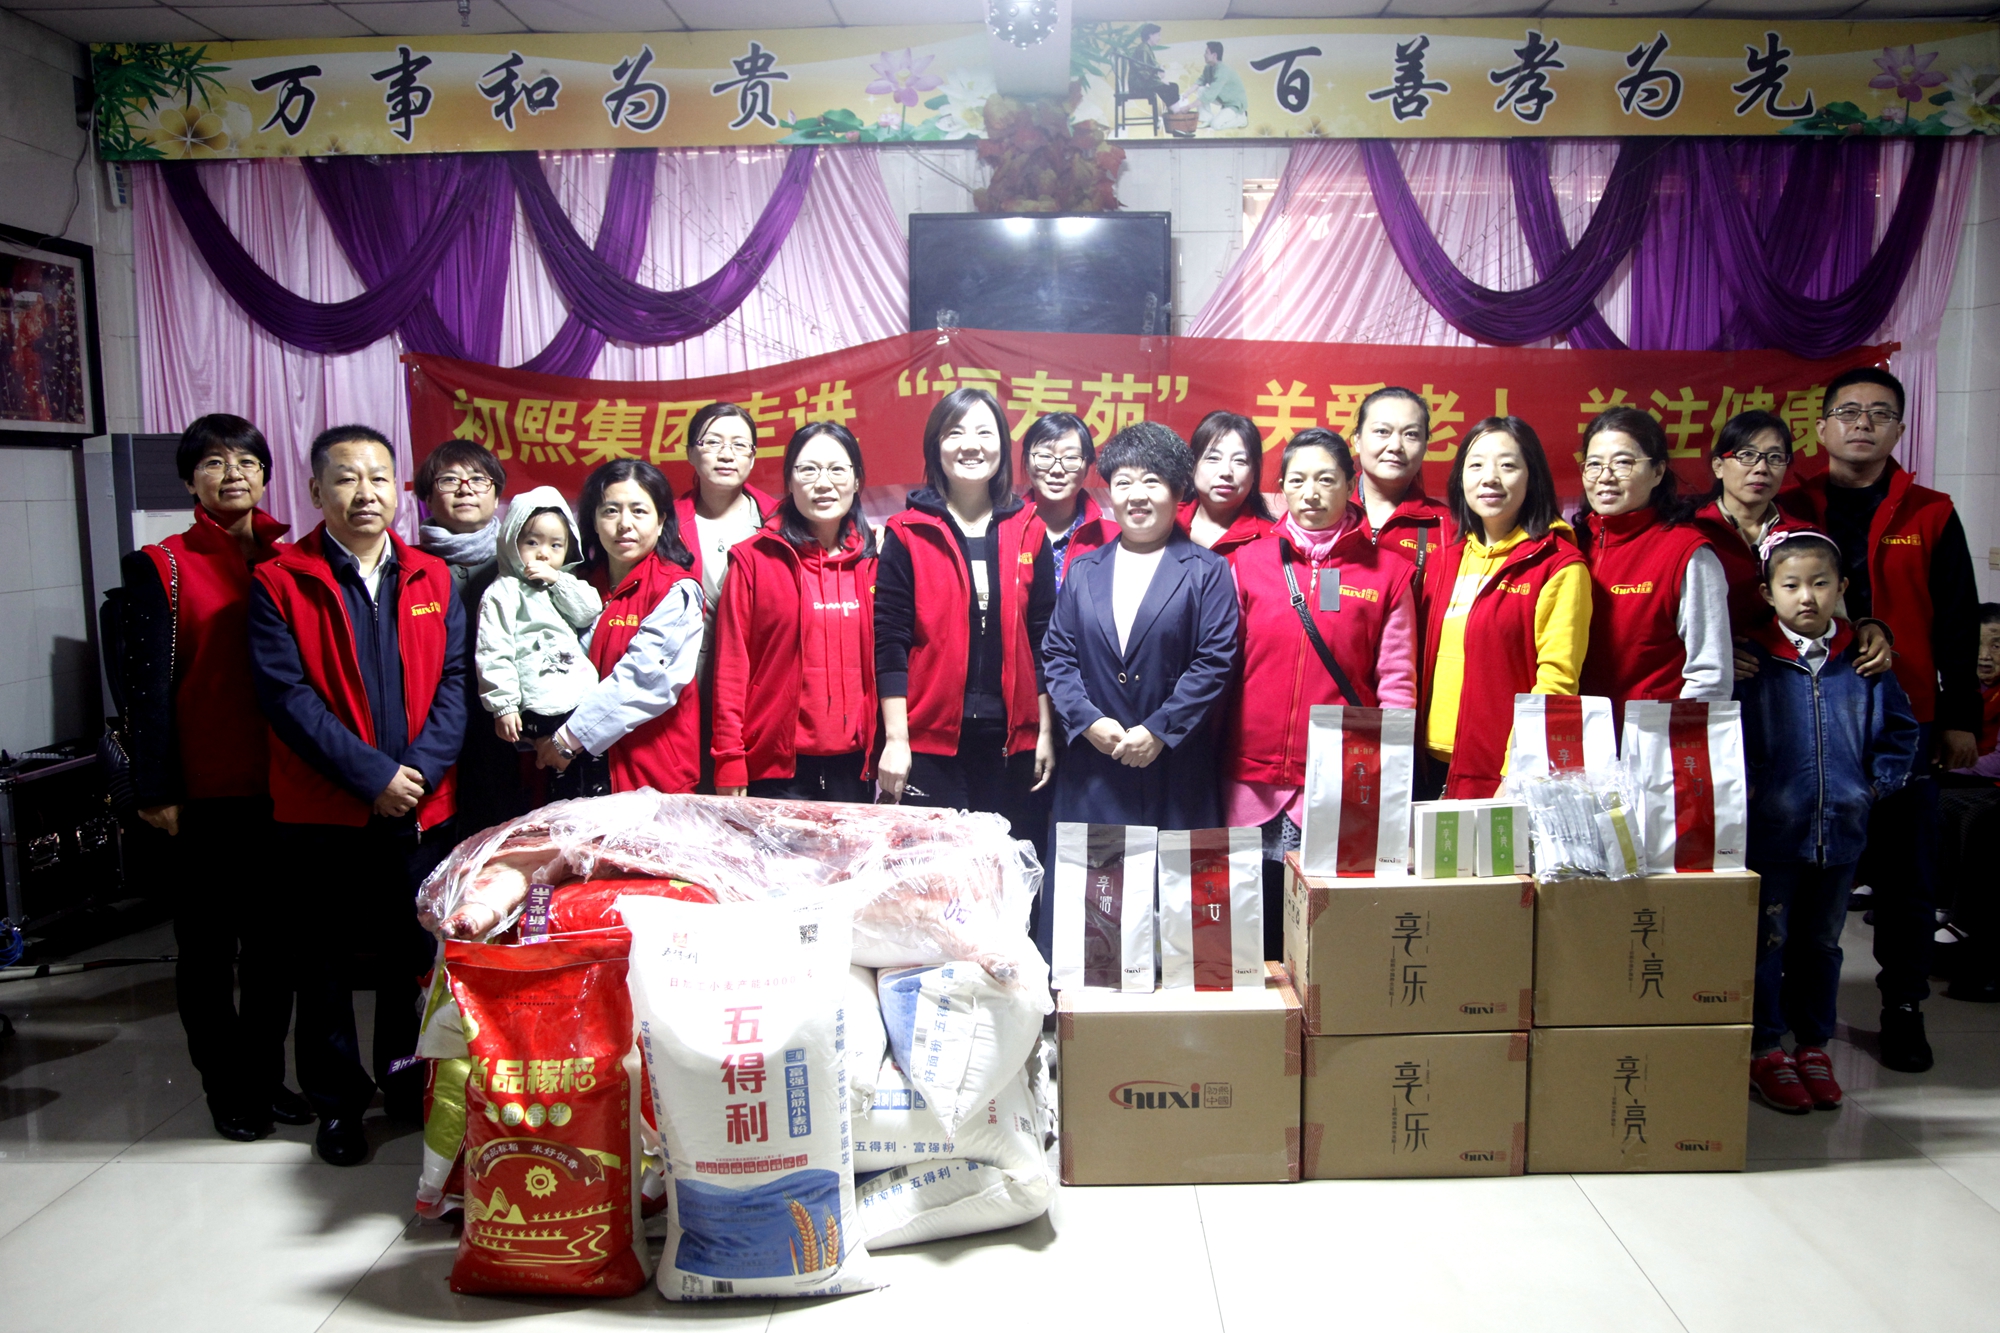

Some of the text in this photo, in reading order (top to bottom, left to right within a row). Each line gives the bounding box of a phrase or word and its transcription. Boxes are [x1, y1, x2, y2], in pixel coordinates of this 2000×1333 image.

[251, 42, 789, 141] 万事和为贵
[1250, 31, 1815, 122] 百善孝为先
[1392, 912, 1428, 1007] 享乐
[1631, 908, 1664, 999] 享亮
[720, 1005, 768, 1145] 五得利
[1392, 1062, 1430, 1153] 享乐
[1614, 1056, 1647, 1146] 享亮
